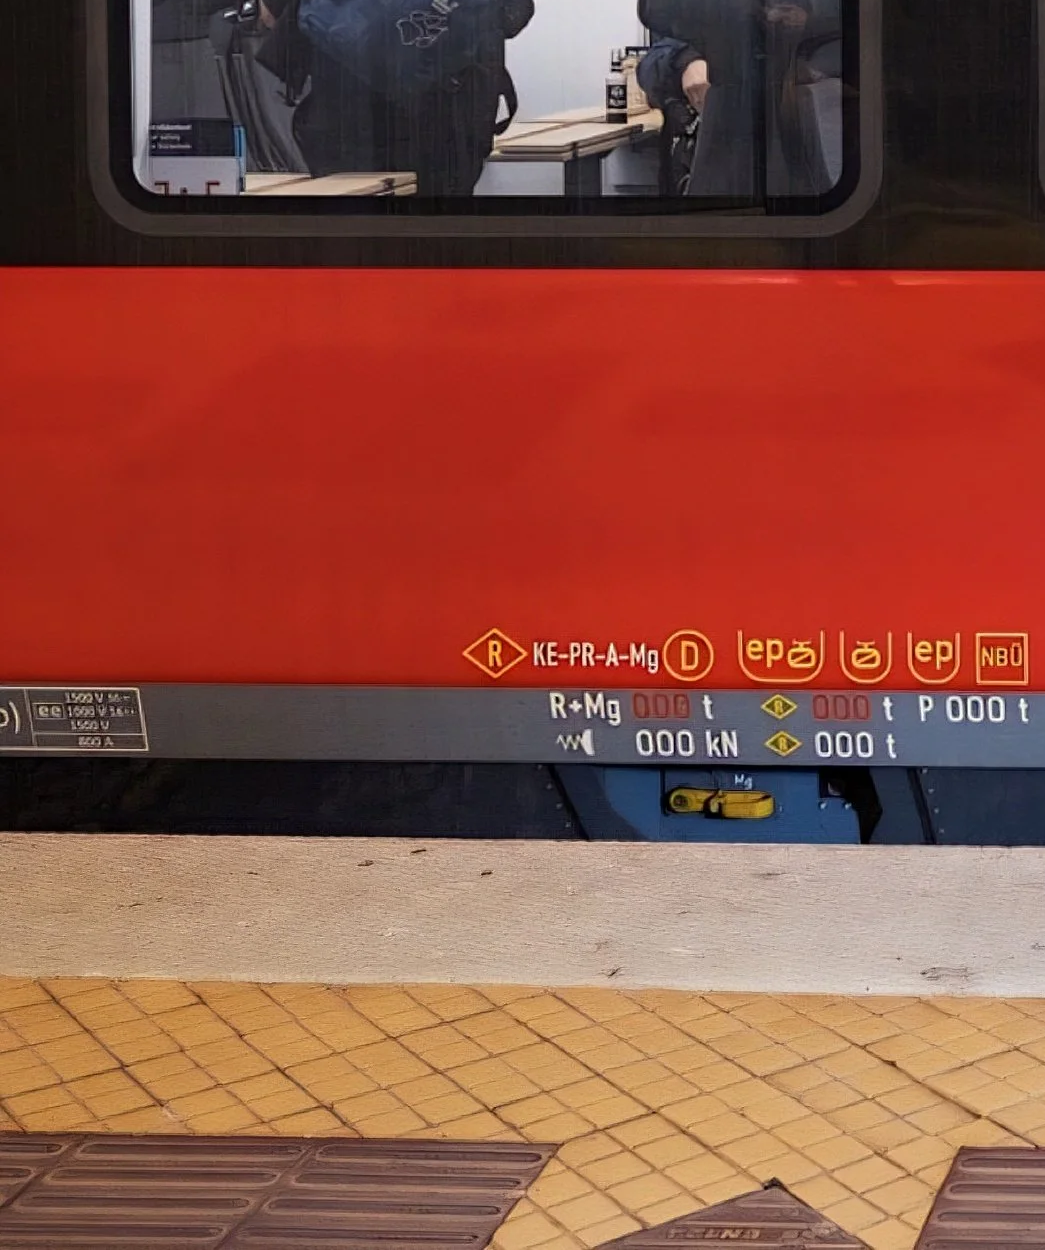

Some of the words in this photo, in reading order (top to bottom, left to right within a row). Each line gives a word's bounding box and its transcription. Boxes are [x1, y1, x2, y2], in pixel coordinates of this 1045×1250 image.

[487, 639, 502, 667] R
[533, 641, 659, 673] KE-PR-A-Mg
[680, 640, 699, 671] D
[914, 640, 953, 670] ep
[549, 692, 621, 726] R+Mg
[702, 693, 714, 720] t
[882, 696, 893, 721] t
[919, 695, 934, 721] P
[945, 695, 1006, 723] 000
[1018, 697, 1029, 722] t
[635, 728, 695, 757] 000
[705, 729, 739, 758] kN
[814, 731, 874, 758] 000
[886, 733, 897, 759] t
